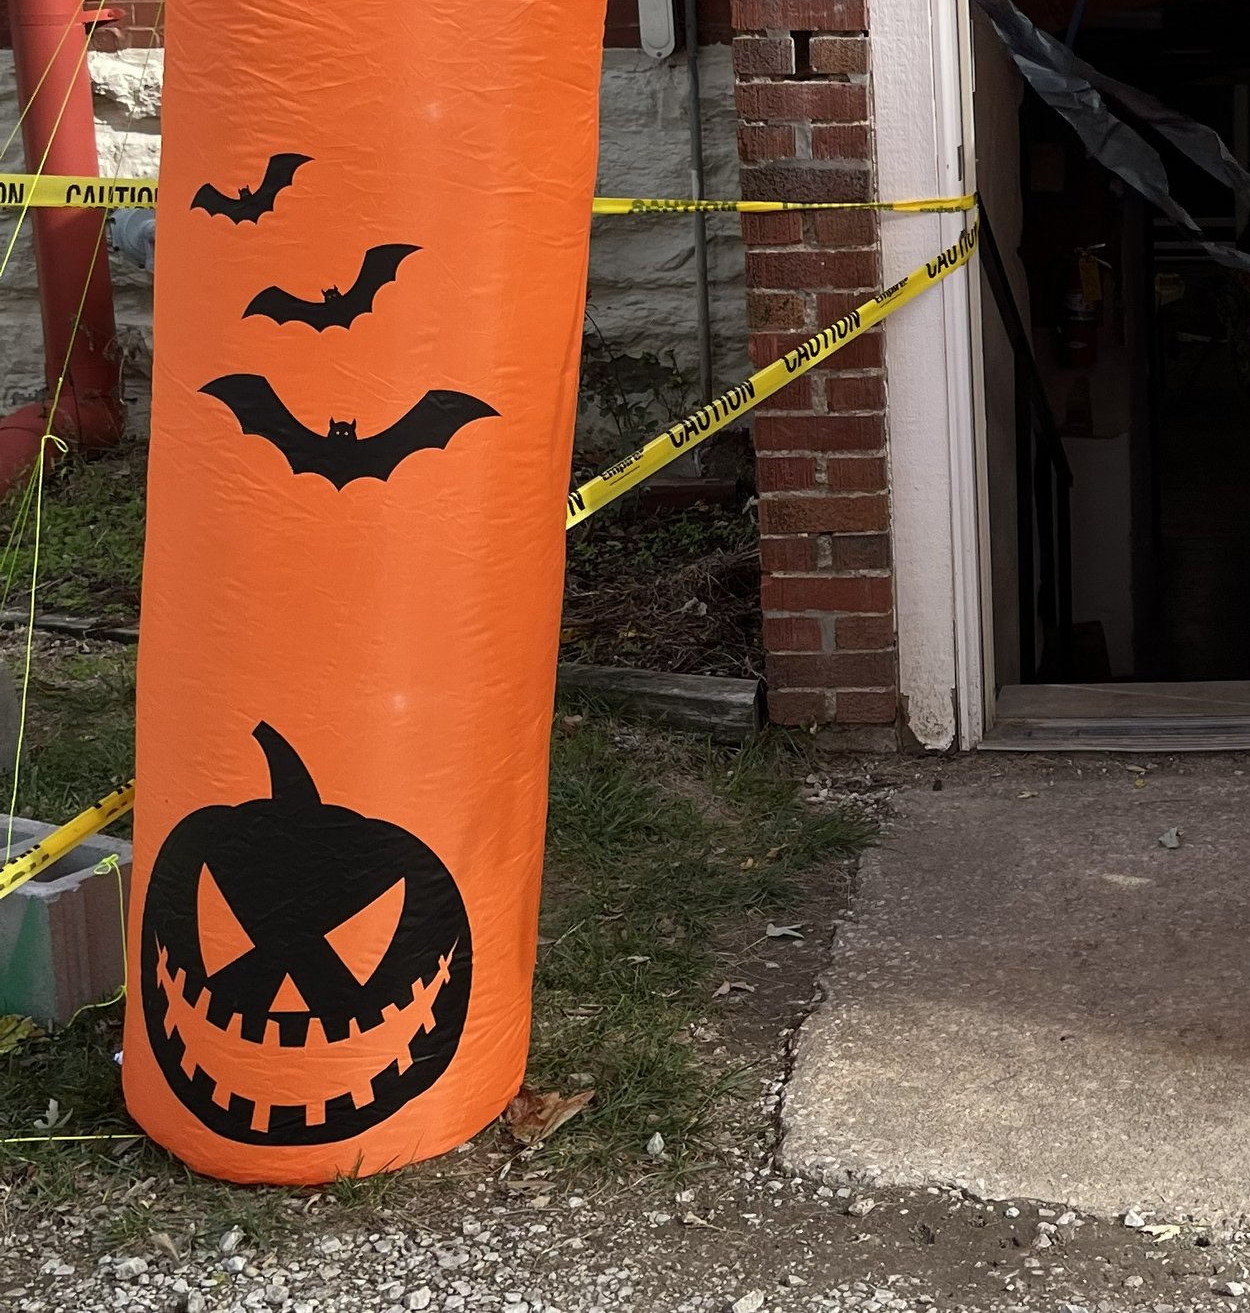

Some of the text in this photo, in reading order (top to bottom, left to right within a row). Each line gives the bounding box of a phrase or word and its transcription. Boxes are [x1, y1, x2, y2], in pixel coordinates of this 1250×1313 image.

[65, 184, 158, 204] CAUTIO
[668, 380, 755, 448] CAUTION
[781, 310, 861, 373] CAUTION
